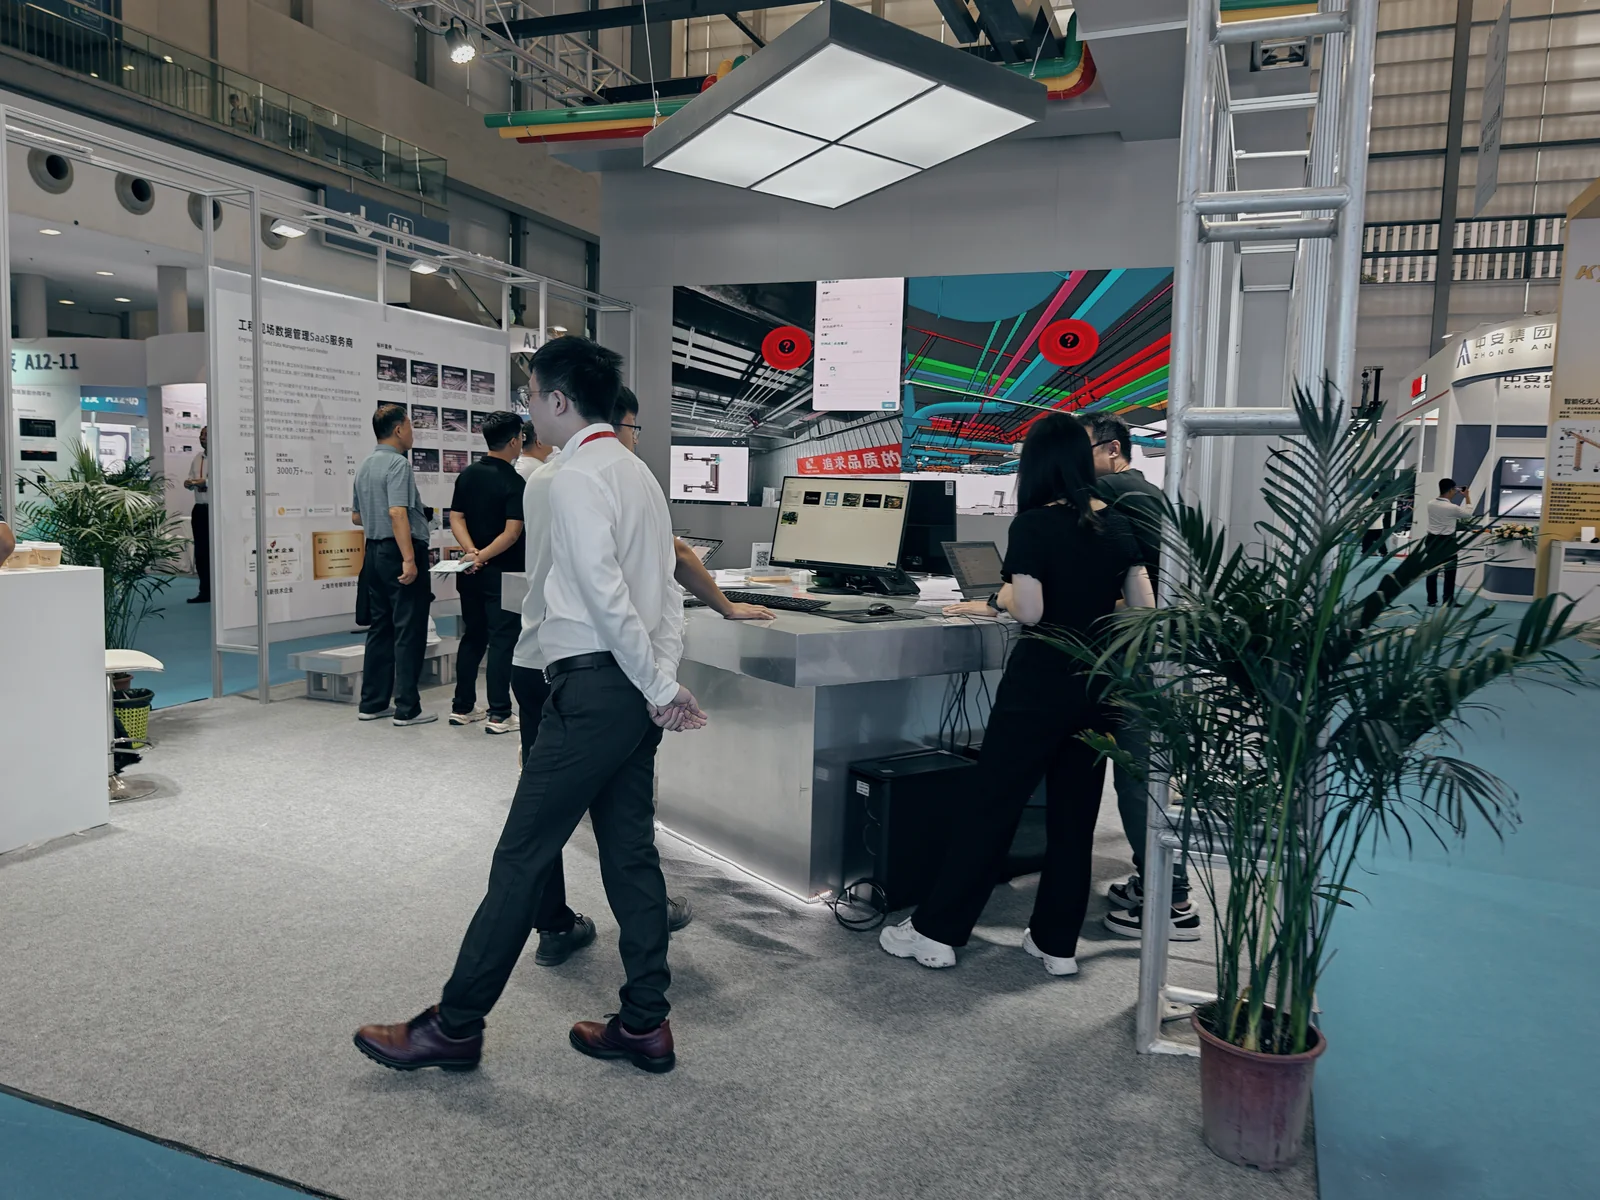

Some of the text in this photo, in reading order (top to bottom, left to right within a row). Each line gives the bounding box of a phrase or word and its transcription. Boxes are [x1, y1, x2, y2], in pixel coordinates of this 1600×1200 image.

[1475, 325, 1553, 349] 中安集团
[25, 353, 79, 370] A12-11
[1474, 347, 1514, 359] ZHONG
[822, 449, 901, 471] 追求品质的
